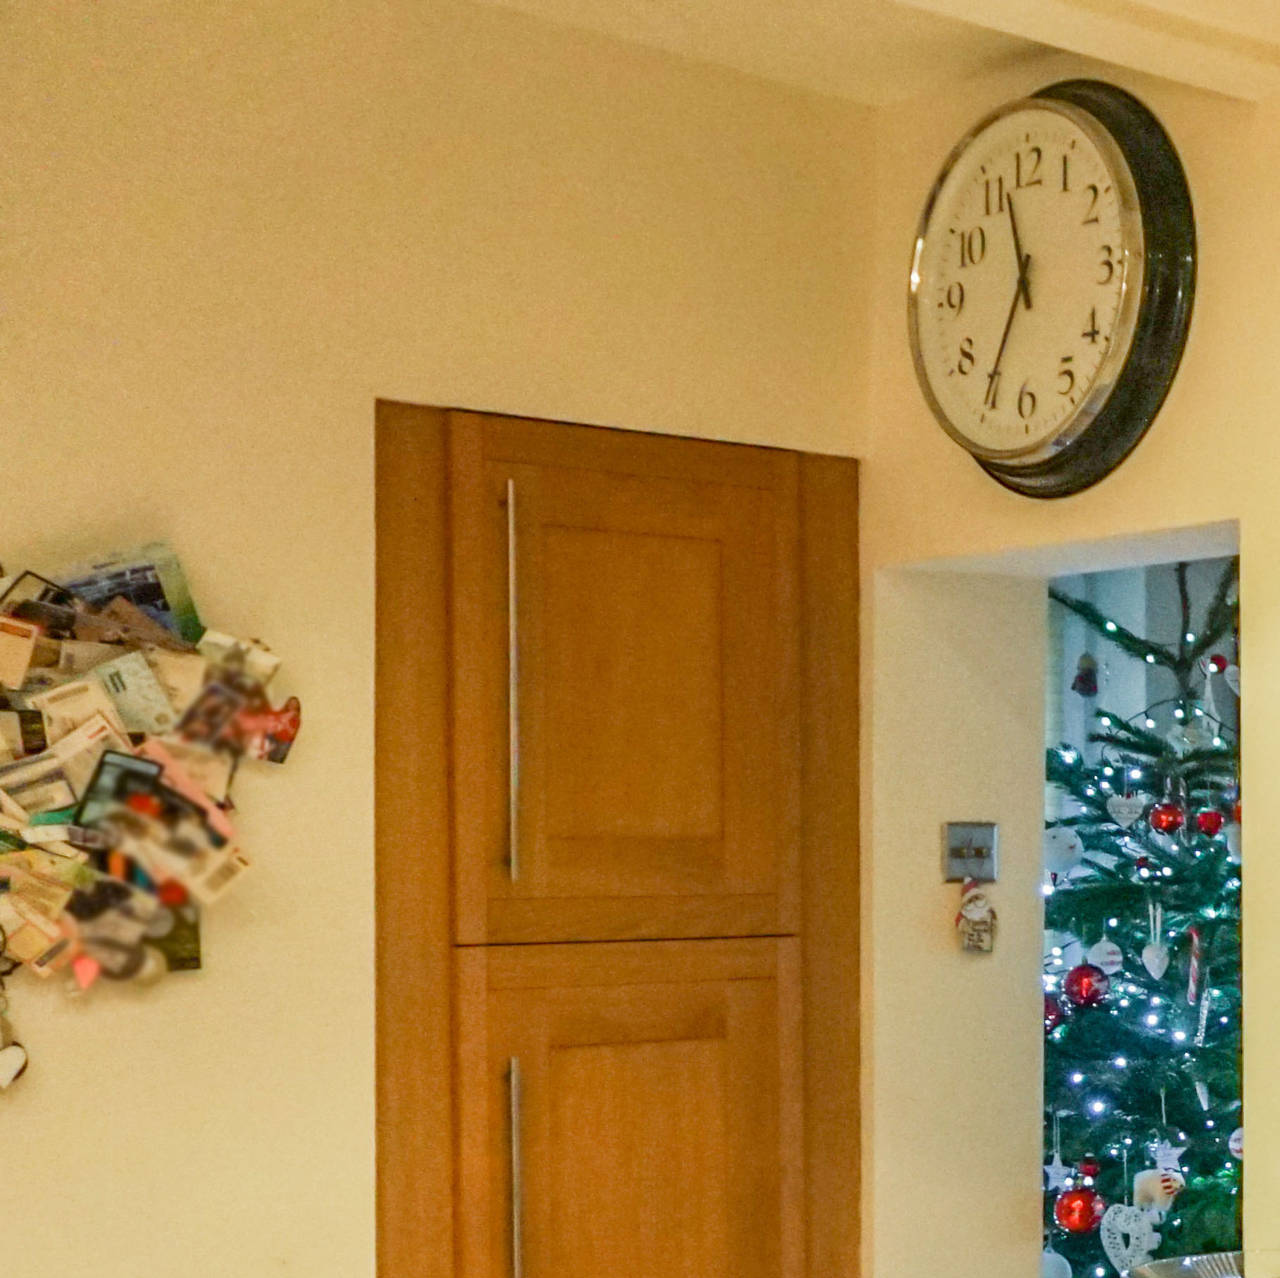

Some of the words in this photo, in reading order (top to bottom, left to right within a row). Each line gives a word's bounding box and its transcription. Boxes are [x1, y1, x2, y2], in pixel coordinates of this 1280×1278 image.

[1014, 146, 1043, 190] 12
[1060, 153, 1070, 192] 1
[982, 174, 1004, 216] 11
[1081, 183, 1099, 226] 2
[958, 226, 987, 269] 10
[1096, 244, 1114, 286] 3
[946, 281, 965, 318] 9
[1081, 306, 1099, 345] 4
[957, 337, 976, 377] 8
[1058, 356, 1076, 396] 5
[1017, 379, 1037, 419] 6
